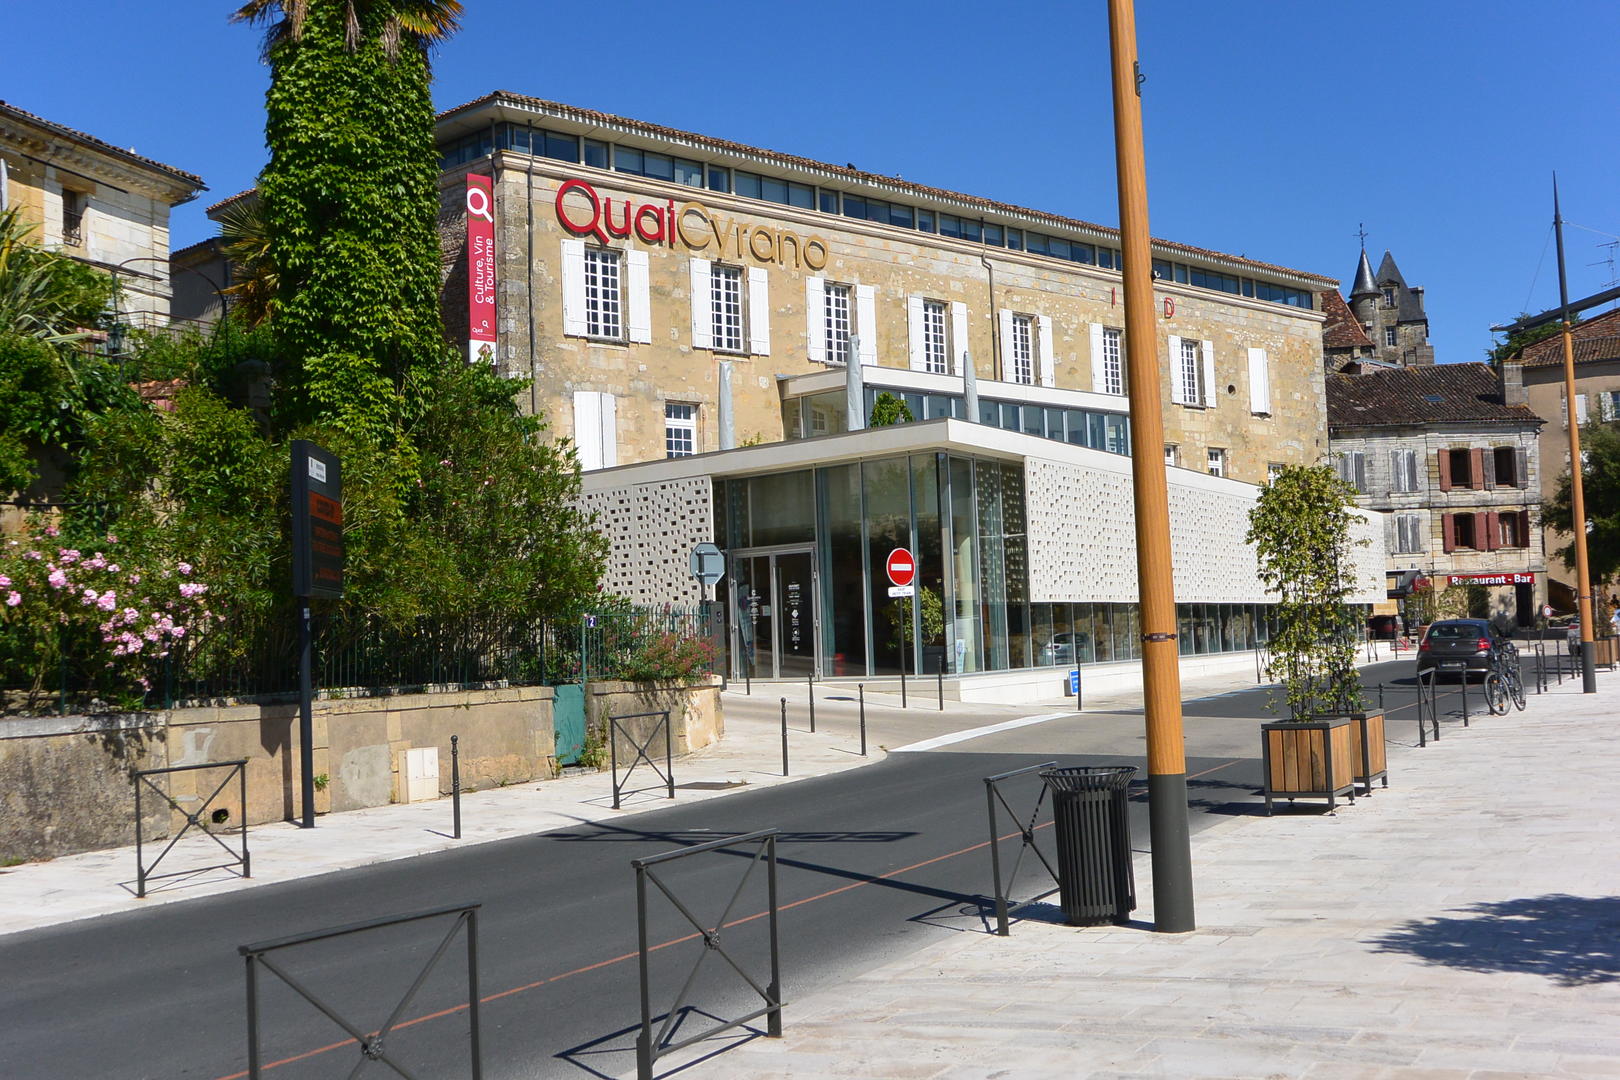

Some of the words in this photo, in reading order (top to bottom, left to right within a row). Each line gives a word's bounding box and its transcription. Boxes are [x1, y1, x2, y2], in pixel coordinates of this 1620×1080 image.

[474, 235, 483, 255] Vin
[485, 238, 494, 291] Tourisme
[475, 258, 484, 303] Culture,
[485, 295, 494, 304] &
[1452, 575, 1506, 586] Resaurant
[1514, 574, 1532, 583] Bar
